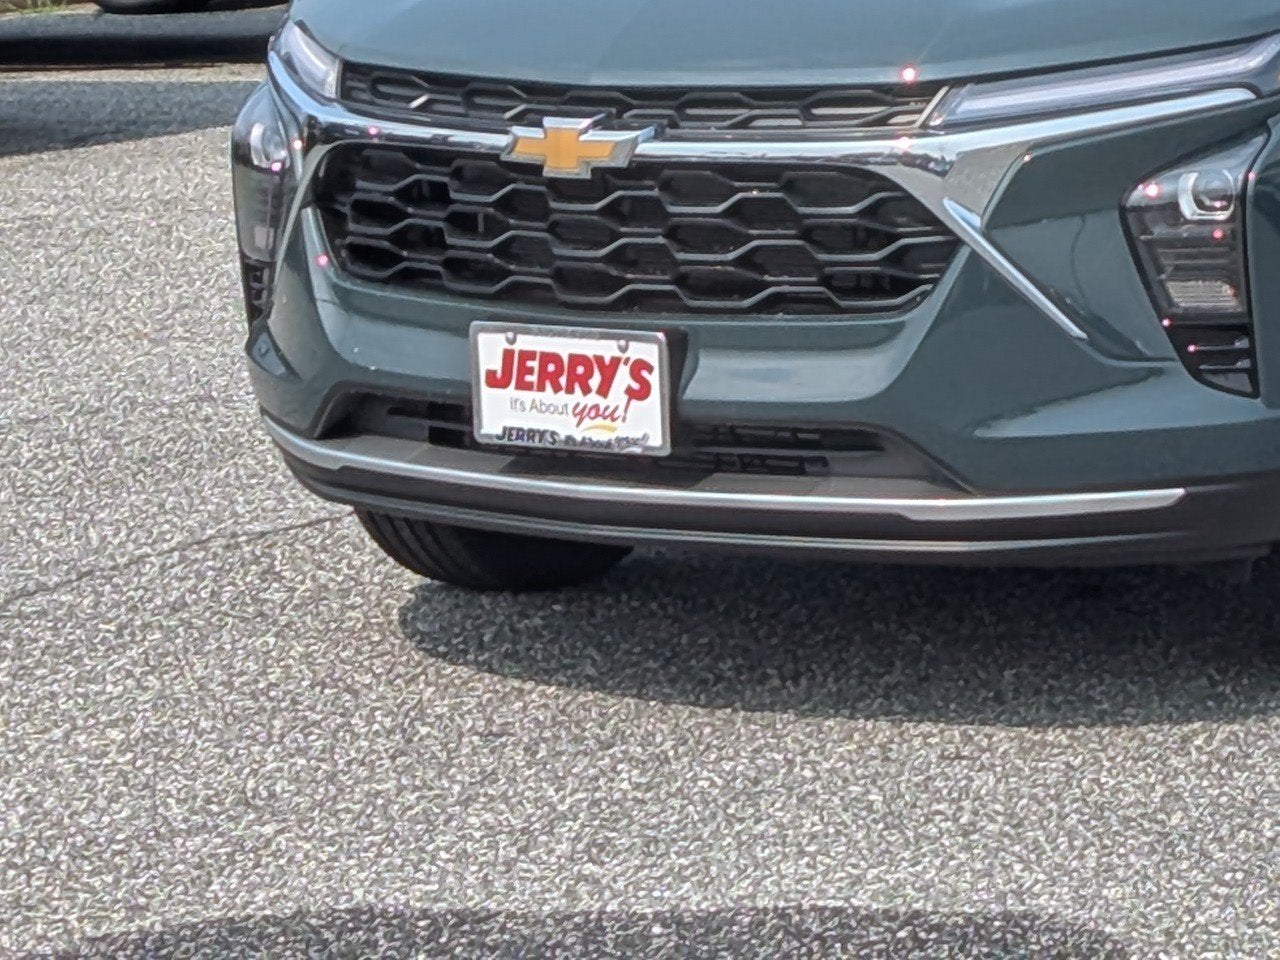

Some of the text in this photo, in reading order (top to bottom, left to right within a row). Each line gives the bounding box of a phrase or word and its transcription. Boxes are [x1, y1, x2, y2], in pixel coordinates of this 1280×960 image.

[484, 348, 655, 401] JERRY'S
[509, 396, 632, 429] It's About you!
